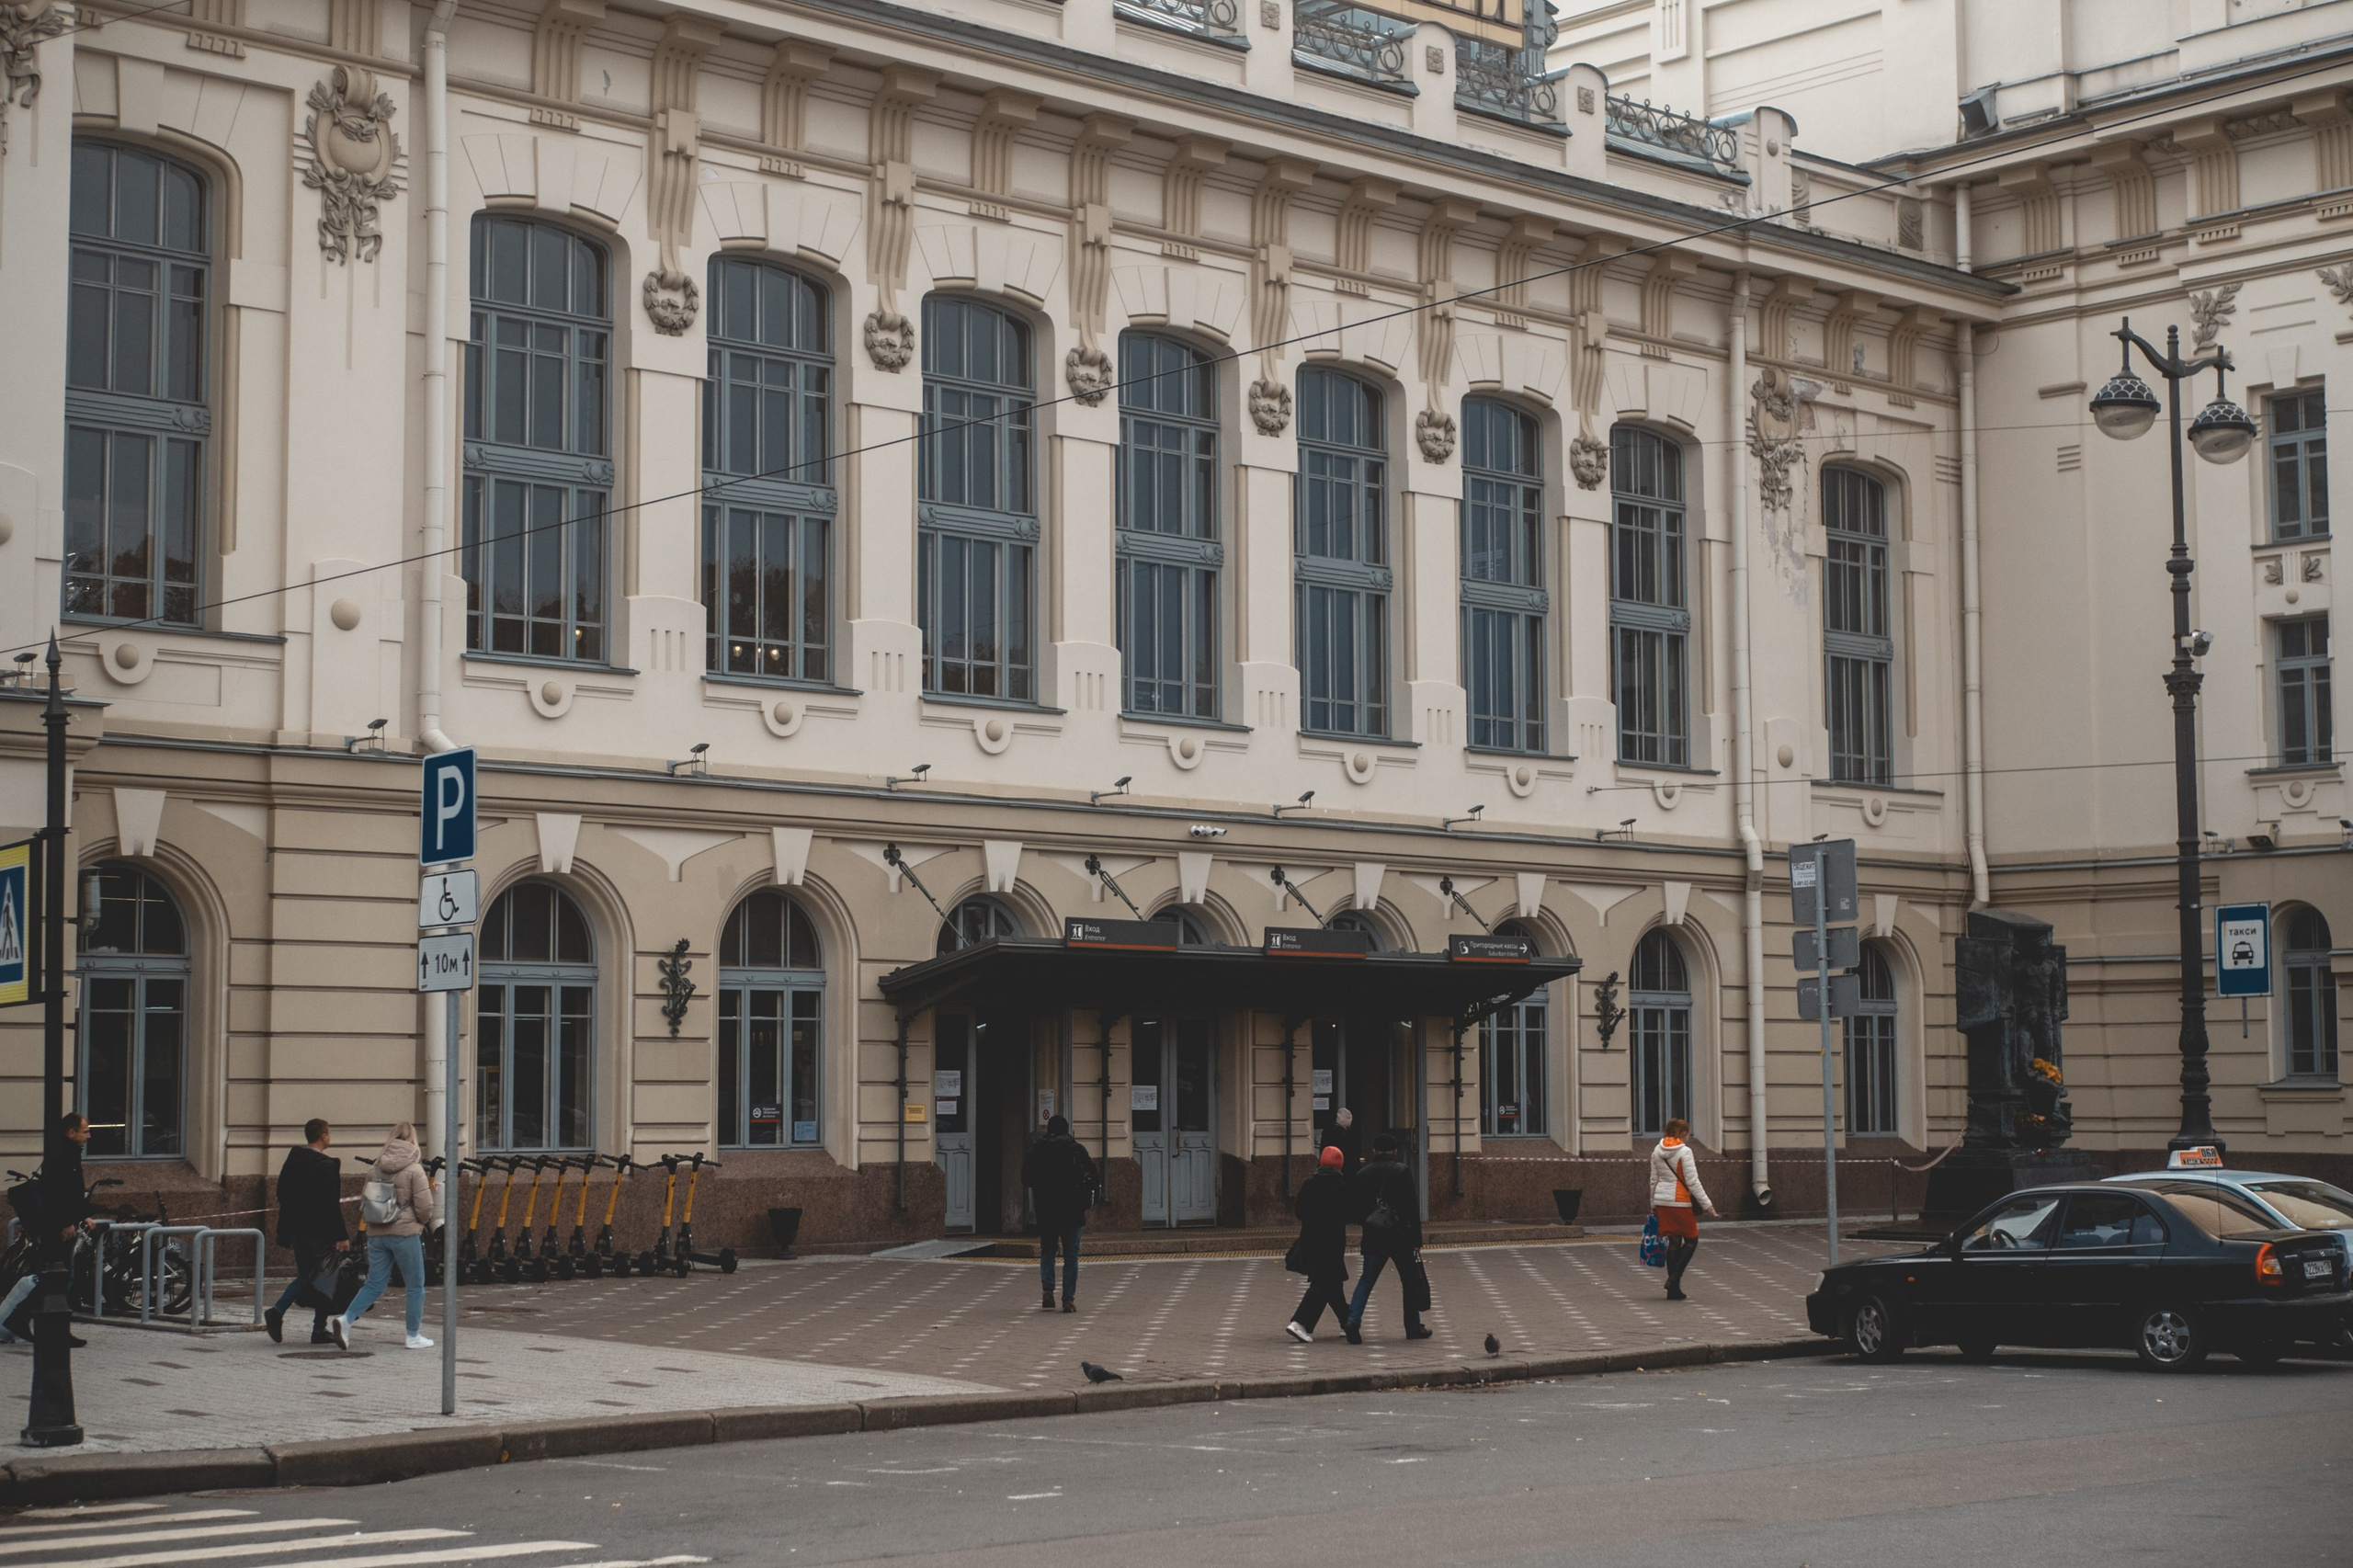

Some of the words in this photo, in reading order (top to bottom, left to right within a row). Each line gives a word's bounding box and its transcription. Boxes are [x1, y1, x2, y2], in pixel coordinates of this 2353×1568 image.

[436, 765, 466, 850] P
[1085, 925, 1100, 933] Вход
[2229, 927, 2256, 936] такси
[1282, 934, 1296, 942] Вход
[1470, 941, 1503, 949] Пригородные
